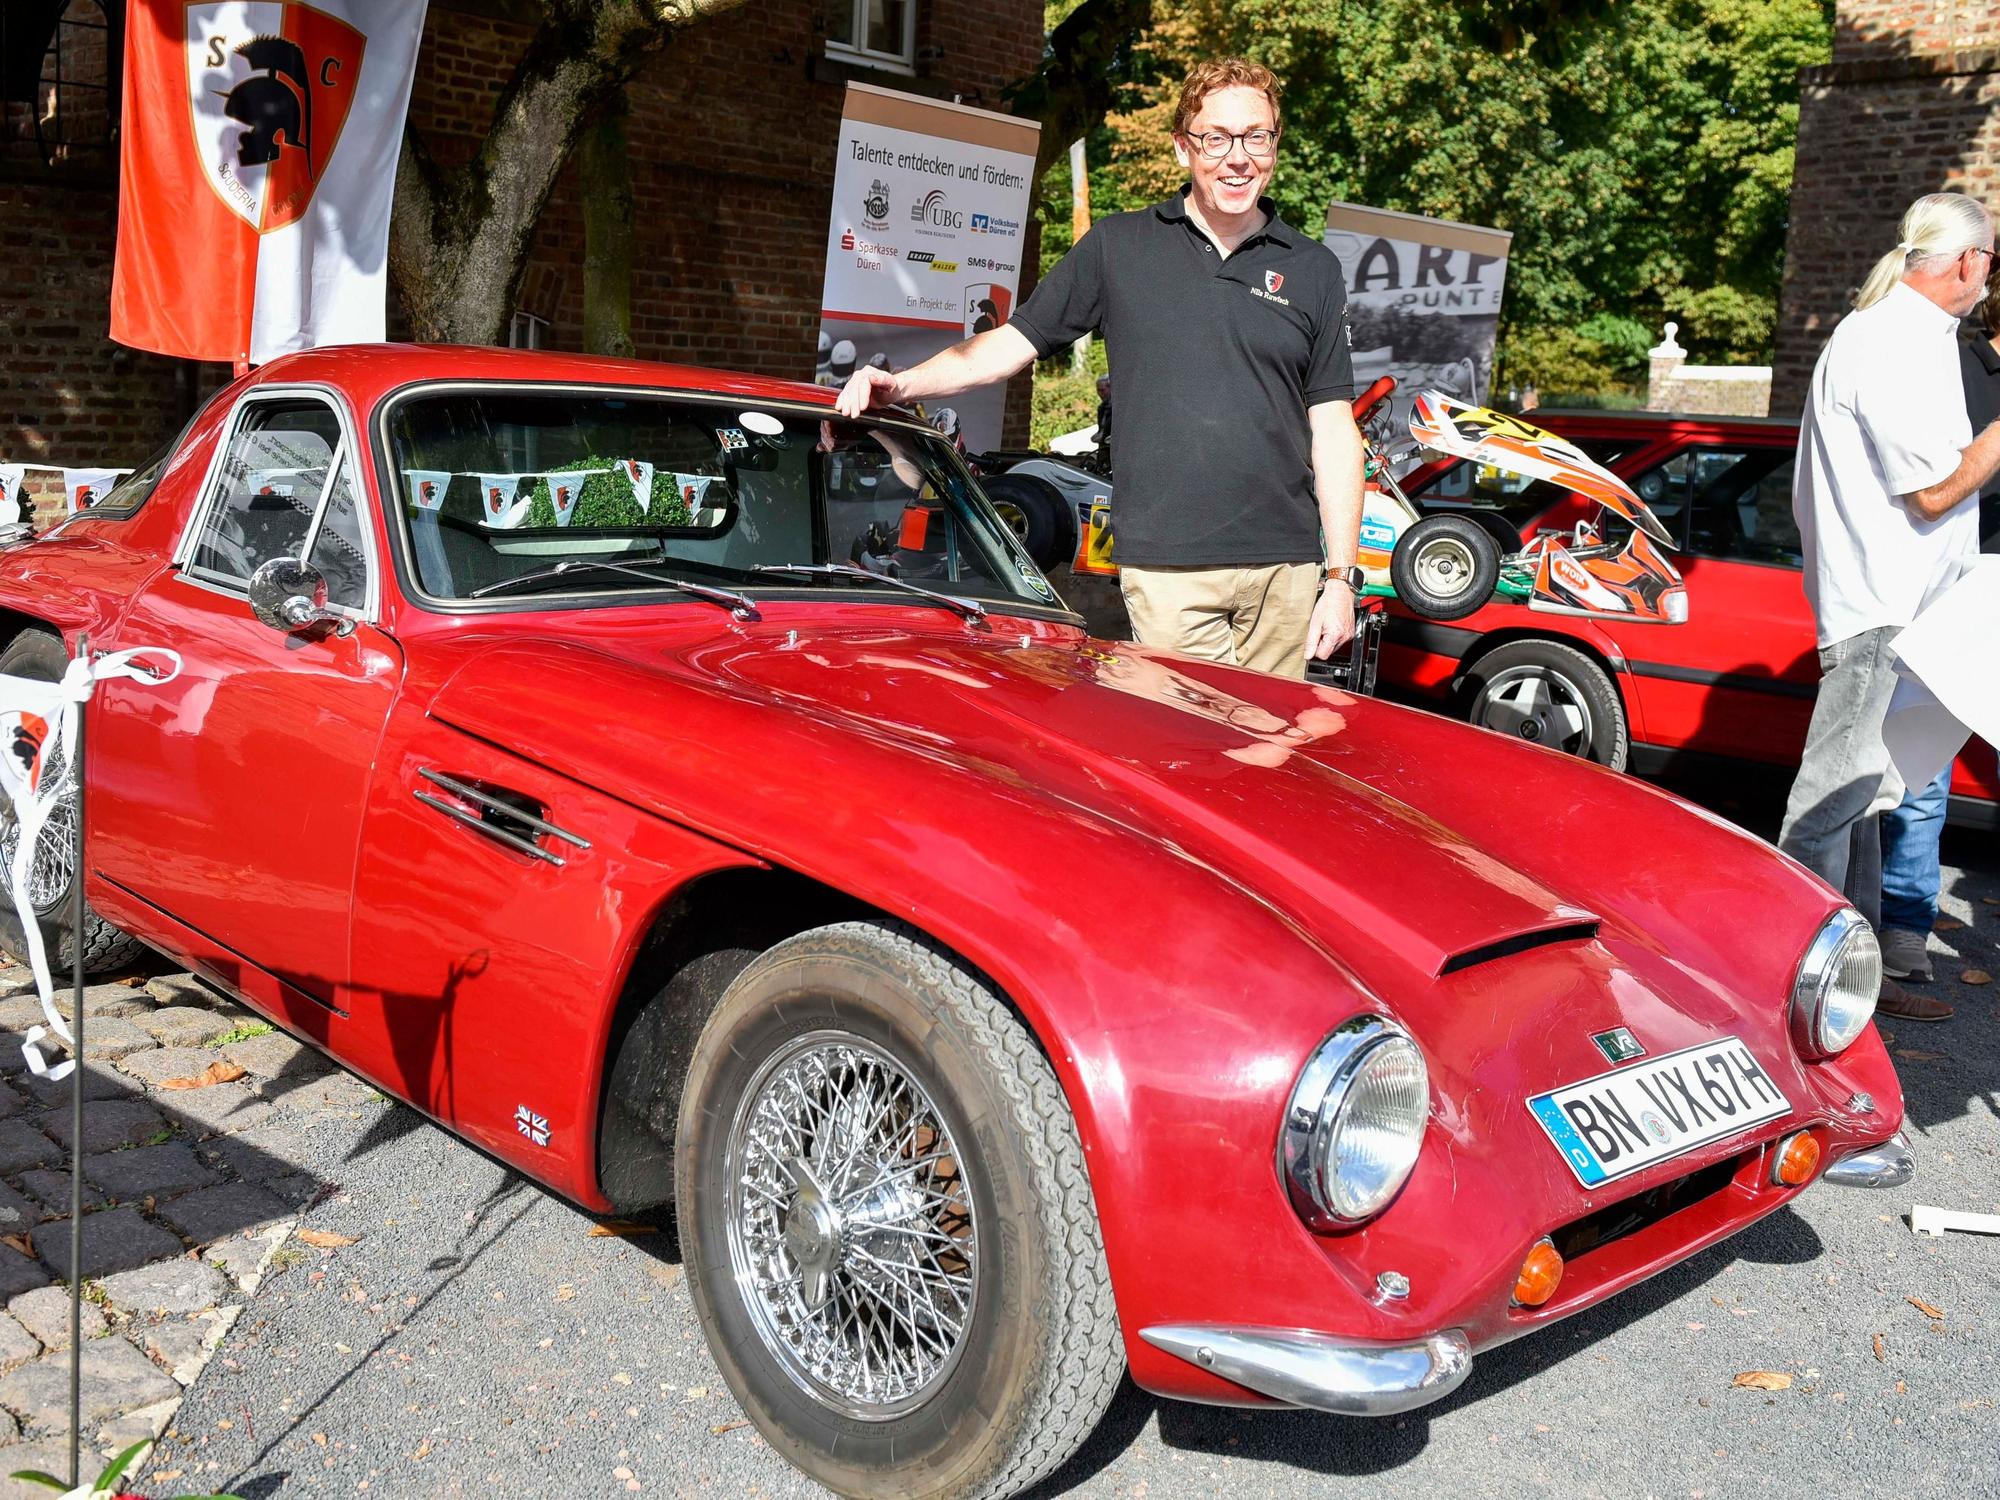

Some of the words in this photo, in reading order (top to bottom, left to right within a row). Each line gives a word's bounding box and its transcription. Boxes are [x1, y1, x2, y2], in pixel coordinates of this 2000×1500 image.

[207, 36, 226, 67] S
[320, 56, 341, 87] C
[851, 139, 894, 166] Talente
[898, 152, 954, 177] entdecken
[958, 163, 979, 181] und
[983, 165, 1024, 189] fördern:
[218, 162, 257, 213] SCUDERIA
[933, 208, 963, 229] UBG
[990, 217, 1019, 229] Volksbank
[989, 226, 1007, 236] Düren
[858, 241, 898, 257] Sparkasse
[857, 257, 881, 271] Düren
[968, 257, 987, 268] SMS
[995, 262, 1016, 273] group
[906, 295, 917, 307] Ein
[920, 297, 943, 312] Projekt
[944, 300, 957, 312] der:
[1563, 1088, 1650, 1163] BN
[1573, 1148, 1590, 1167] D
